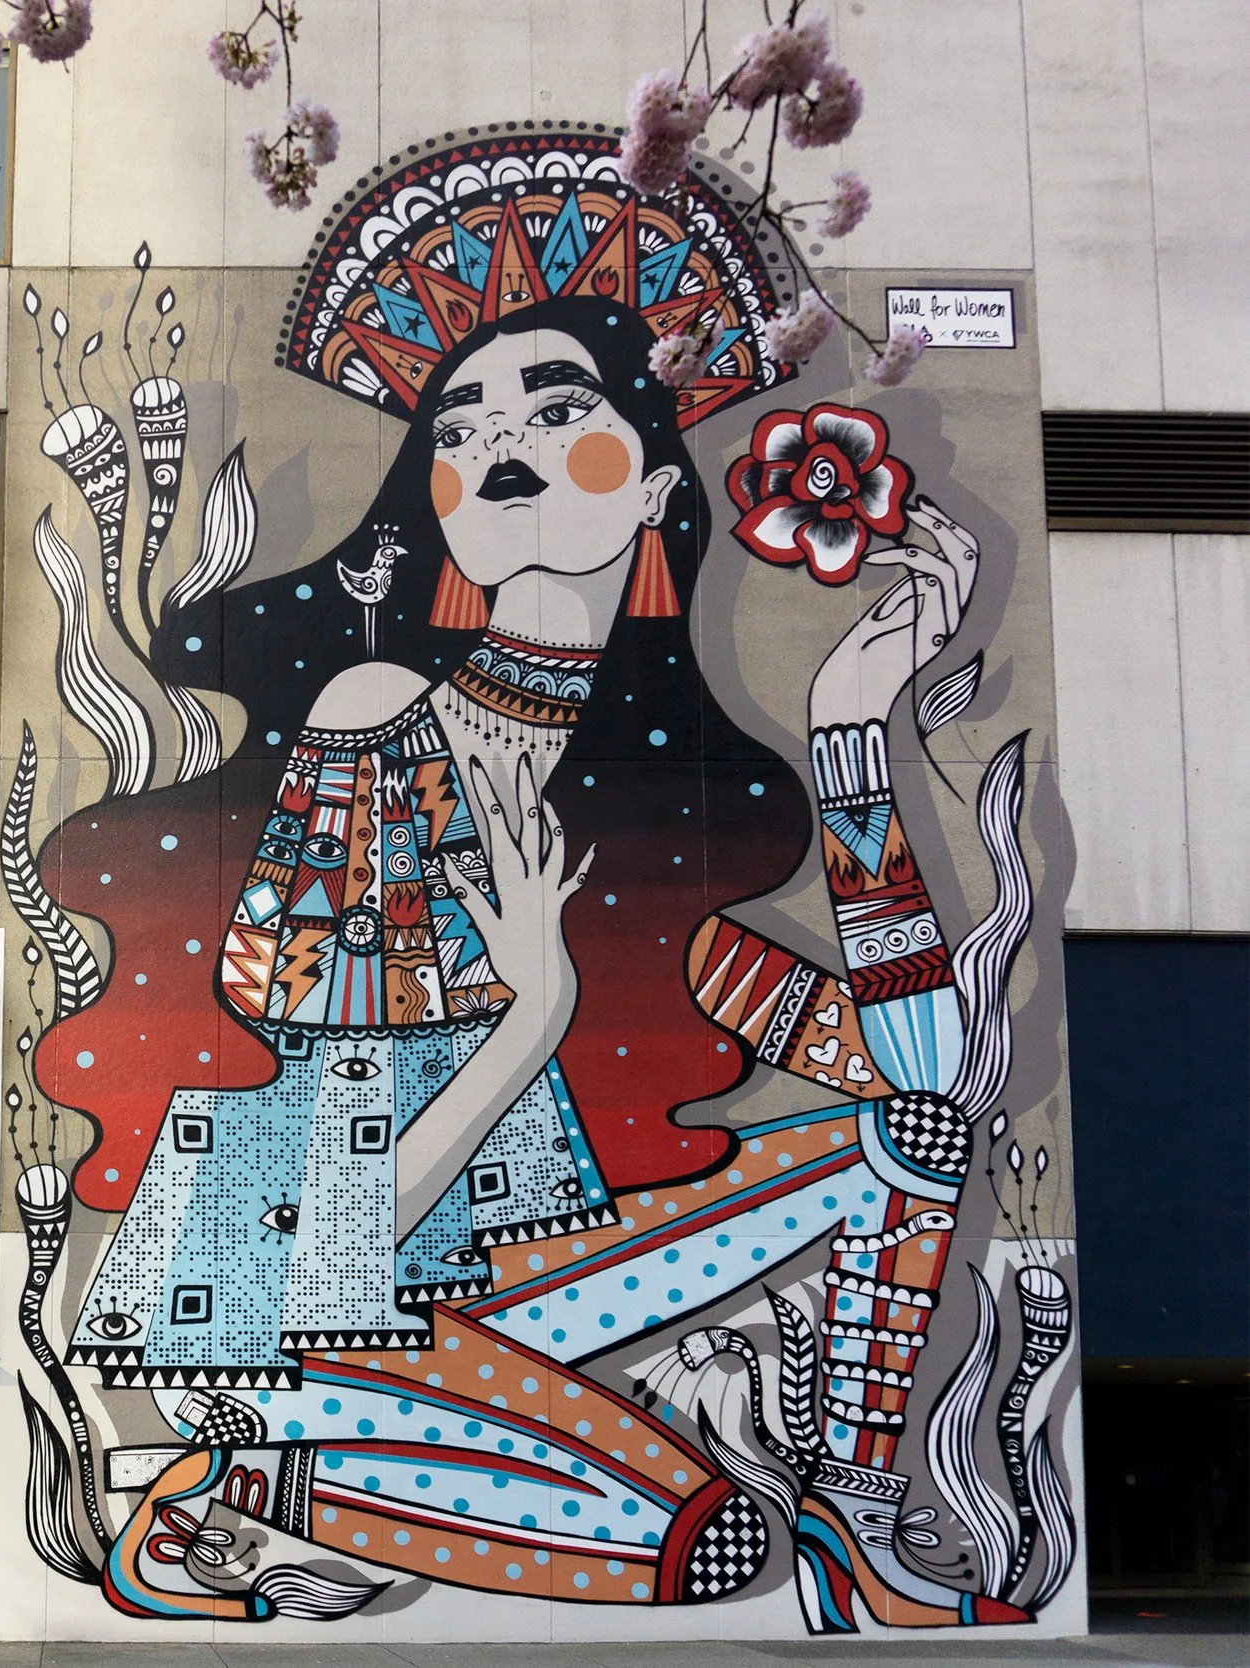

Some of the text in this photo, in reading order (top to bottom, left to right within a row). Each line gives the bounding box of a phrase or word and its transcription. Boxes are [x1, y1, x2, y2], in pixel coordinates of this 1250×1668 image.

[892, 295, 1006, 320] Wall for Women
[965, 330, 999, 338] YWCA
